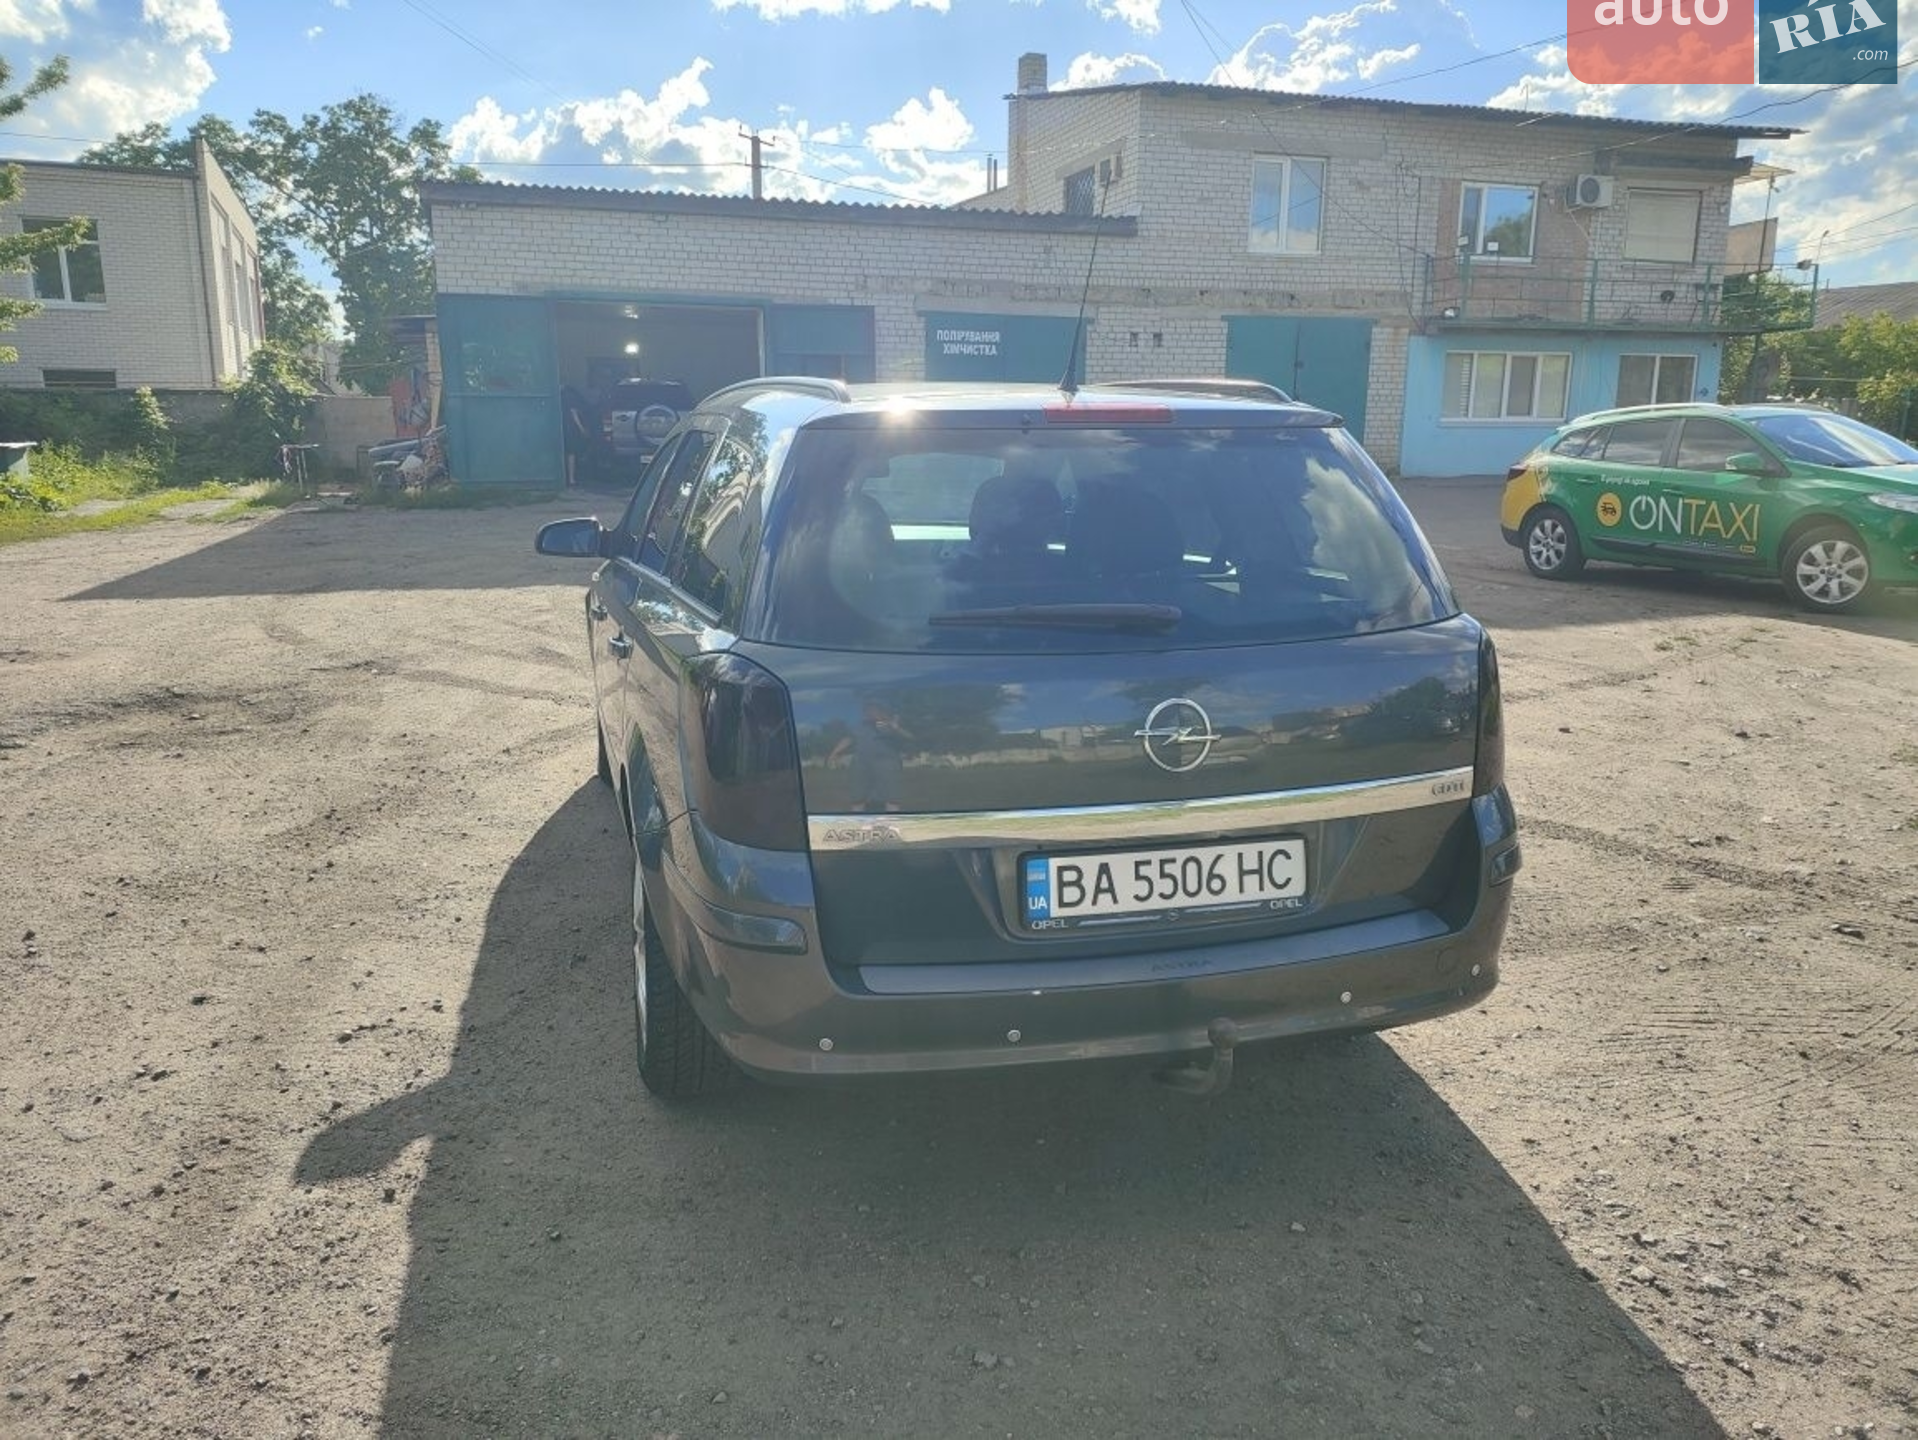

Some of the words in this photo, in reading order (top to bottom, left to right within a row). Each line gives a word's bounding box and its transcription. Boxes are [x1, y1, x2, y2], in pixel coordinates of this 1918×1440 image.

[823, 826, 900, 842] ASTRA
[1056, 862, 1119, 909] BA
[1132, 854, 1227, 902] 5506
[1237, 848, 1292, 894] HC
[1028, 896, 1048, 910] UA
[1031, 918, 1069, 930] OPEL
